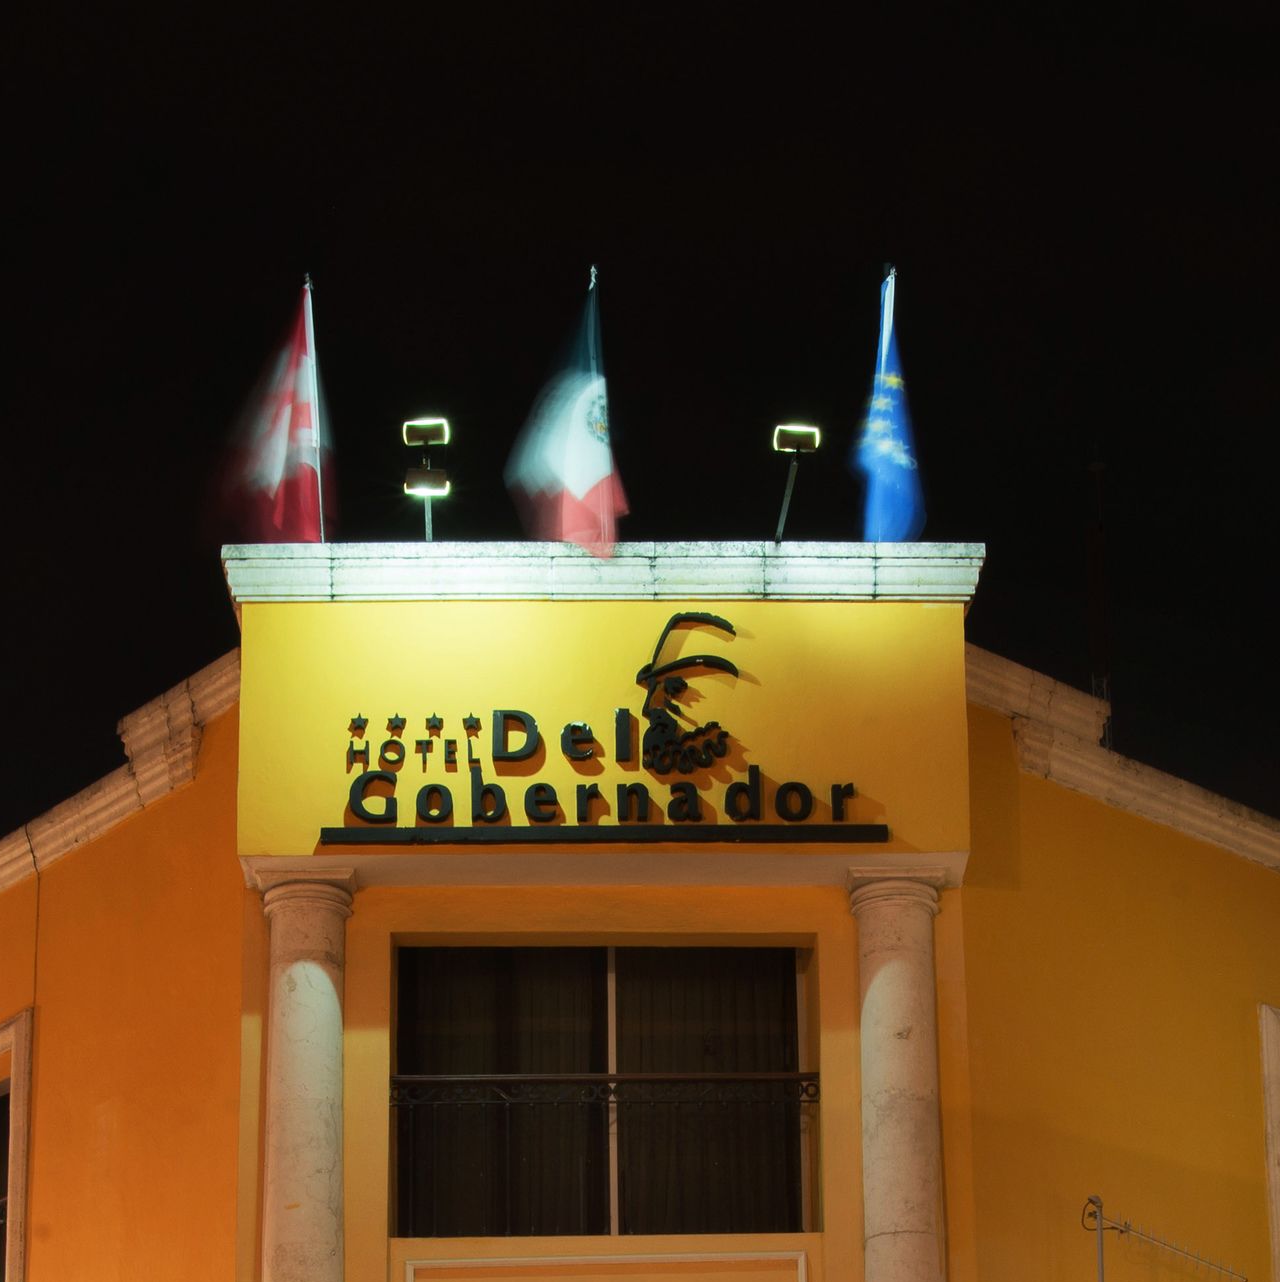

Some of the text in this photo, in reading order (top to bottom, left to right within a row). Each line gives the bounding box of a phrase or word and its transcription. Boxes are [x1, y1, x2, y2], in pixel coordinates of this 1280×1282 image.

[349, 708, 630, 766] HOTEL Del
[349, 764, 854, 824] Gobernador
